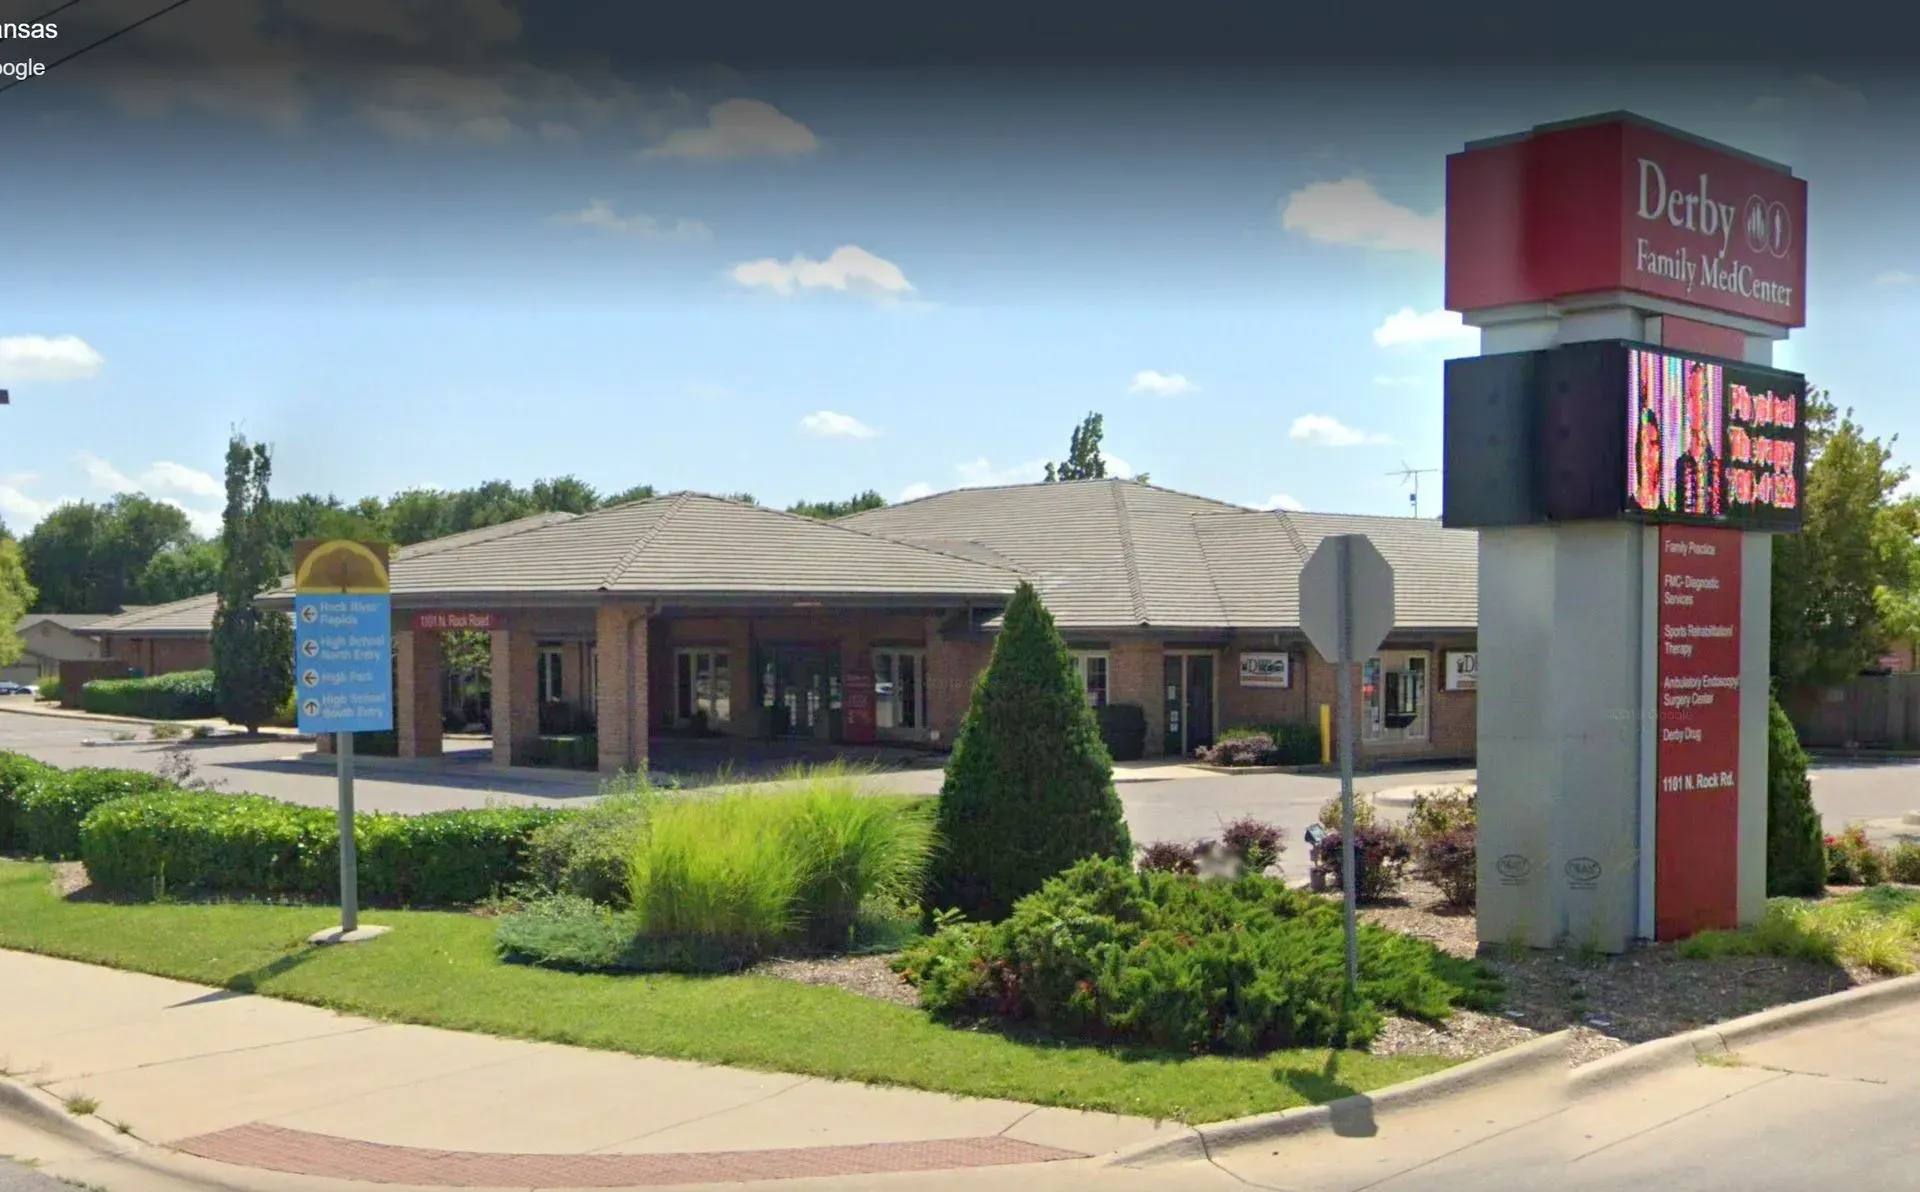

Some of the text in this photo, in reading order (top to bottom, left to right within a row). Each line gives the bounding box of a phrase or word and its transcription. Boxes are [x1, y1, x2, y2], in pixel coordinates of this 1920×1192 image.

[1637, 158, 1736, 259] Derby
[1637, 237, 1792, 306] Family MedCenter
[1665, 540, 1716, 556] Family Practice
[1685, 575, 1720, 591] Diagnostic
[1664, 591, 1694, 605] Services
[320, 602, 379, 613] Rock River
[320, 614, 358, 628] Rapids
[448, 614, 467, 627] Rock
[468, 613, 490, 626] Road
[1664, 624, 1687, 639] Sports
[320, 635, 385, 649] High School
[320, 650, 381, 663] North Entry
[1665, 642, 1693, 657] Therapy
[321, 671, 374, 685] High Park
[1664, 676, 1701, 690] Ambulatory
[322, 692, 386, 706] High School
[1663, 692, 1715, 709] Surgery Center
[322, 706, 383, 720] South Entry
[1663, 727, 1702, 743] Derby Drug
[1663, 771, 1735, 792] 1101 N. Rock Rd.
